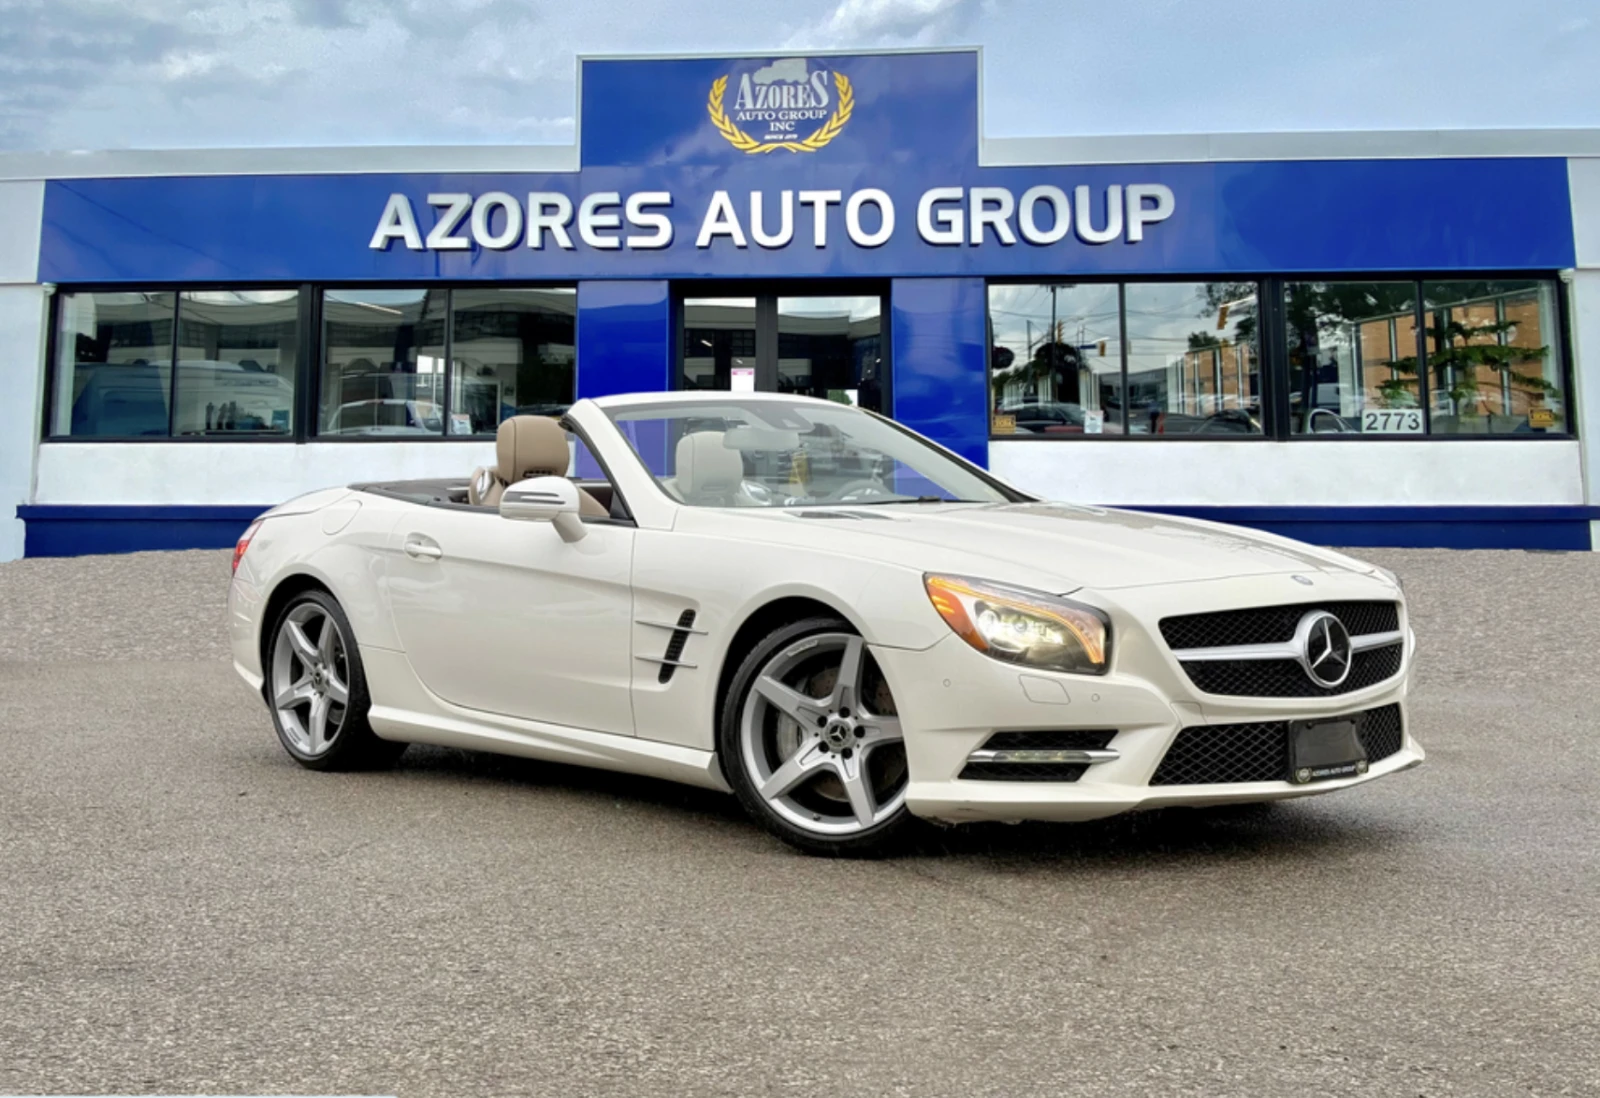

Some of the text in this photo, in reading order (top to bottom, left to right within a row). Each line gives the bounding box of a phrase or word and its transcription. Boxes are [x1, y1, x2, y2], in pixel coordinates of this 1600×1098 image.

[733, 70, 829, 110] AZORES
[736, 109, 828, 121] AUTO GROUP
[769, 121, 796, 132] INC
[369, 184, 1176, 250] AZORES AUTO GROUP
[1365, 412, 1421, 431] 2773
